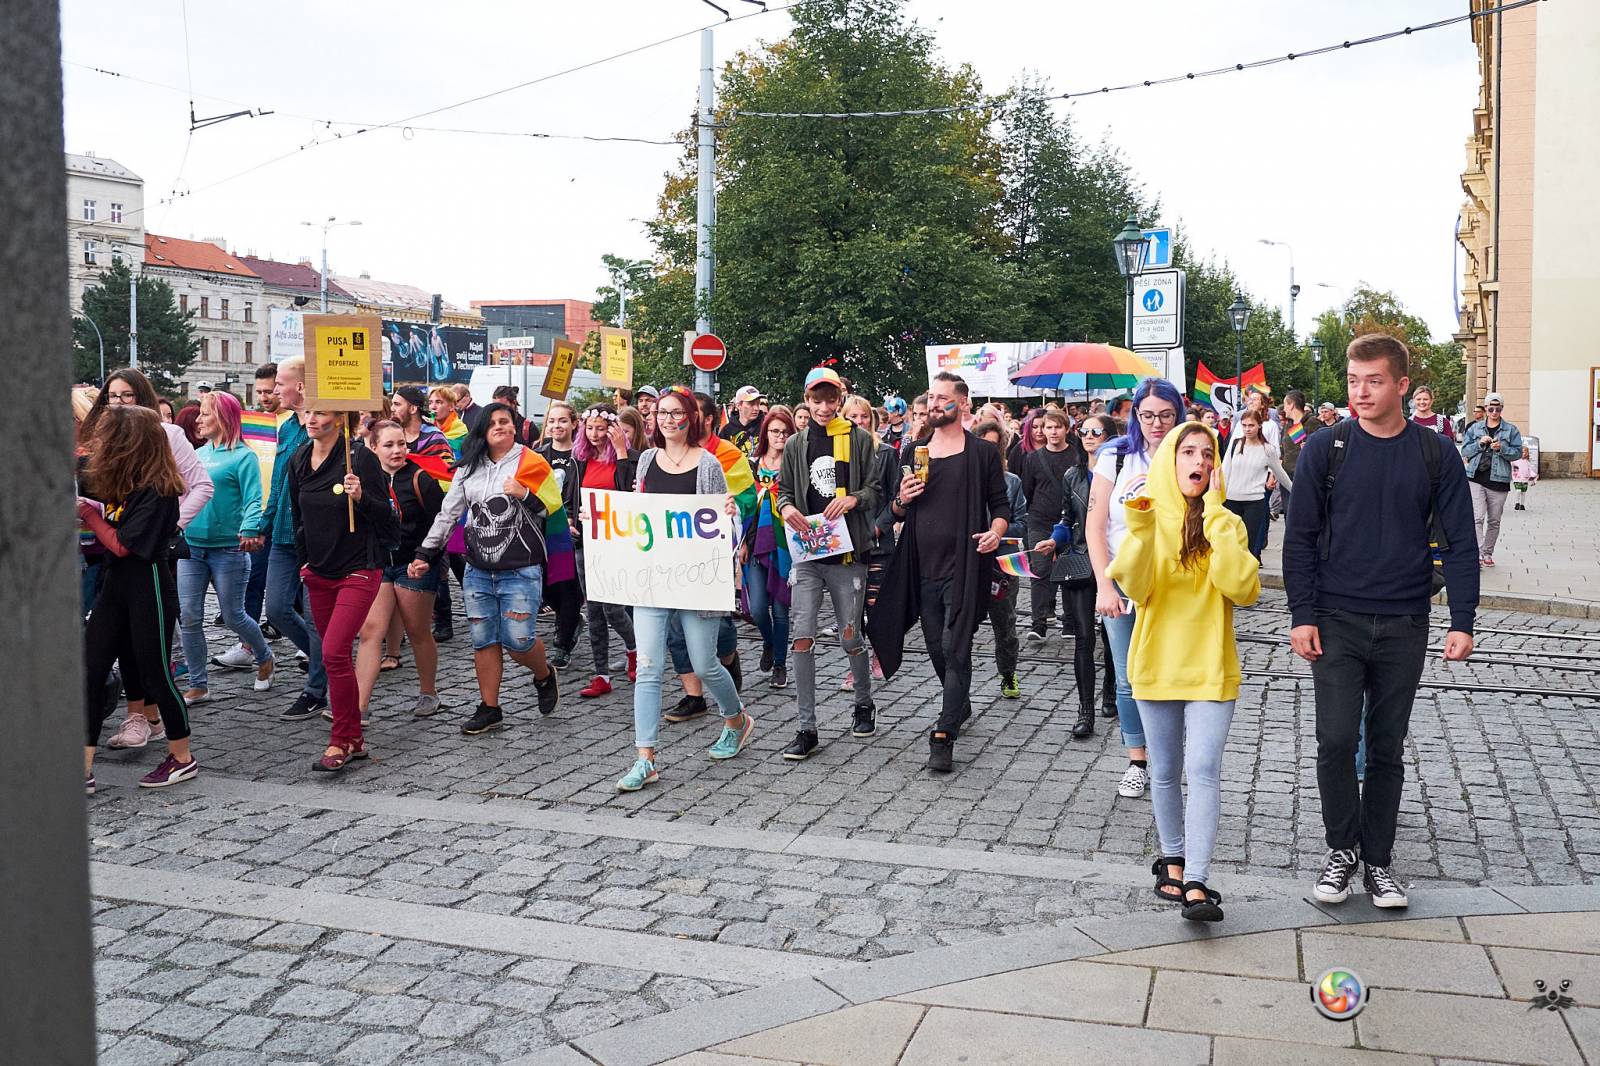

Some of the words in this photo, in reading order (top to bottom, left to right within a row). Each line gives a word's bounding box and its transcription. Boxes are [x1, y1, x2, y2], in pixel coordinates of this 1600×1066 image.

[327, 336, 348, 346] PUSA
[468, 352, 483, 361] talent
[328, 359, 359, 367] DEPORTACE
[589, 492, 654, 552] Hug
[665, 507, 726, 540] me.
[800, 525, 829, 539] FREE
[802, 536, 834, 550] HUGS
